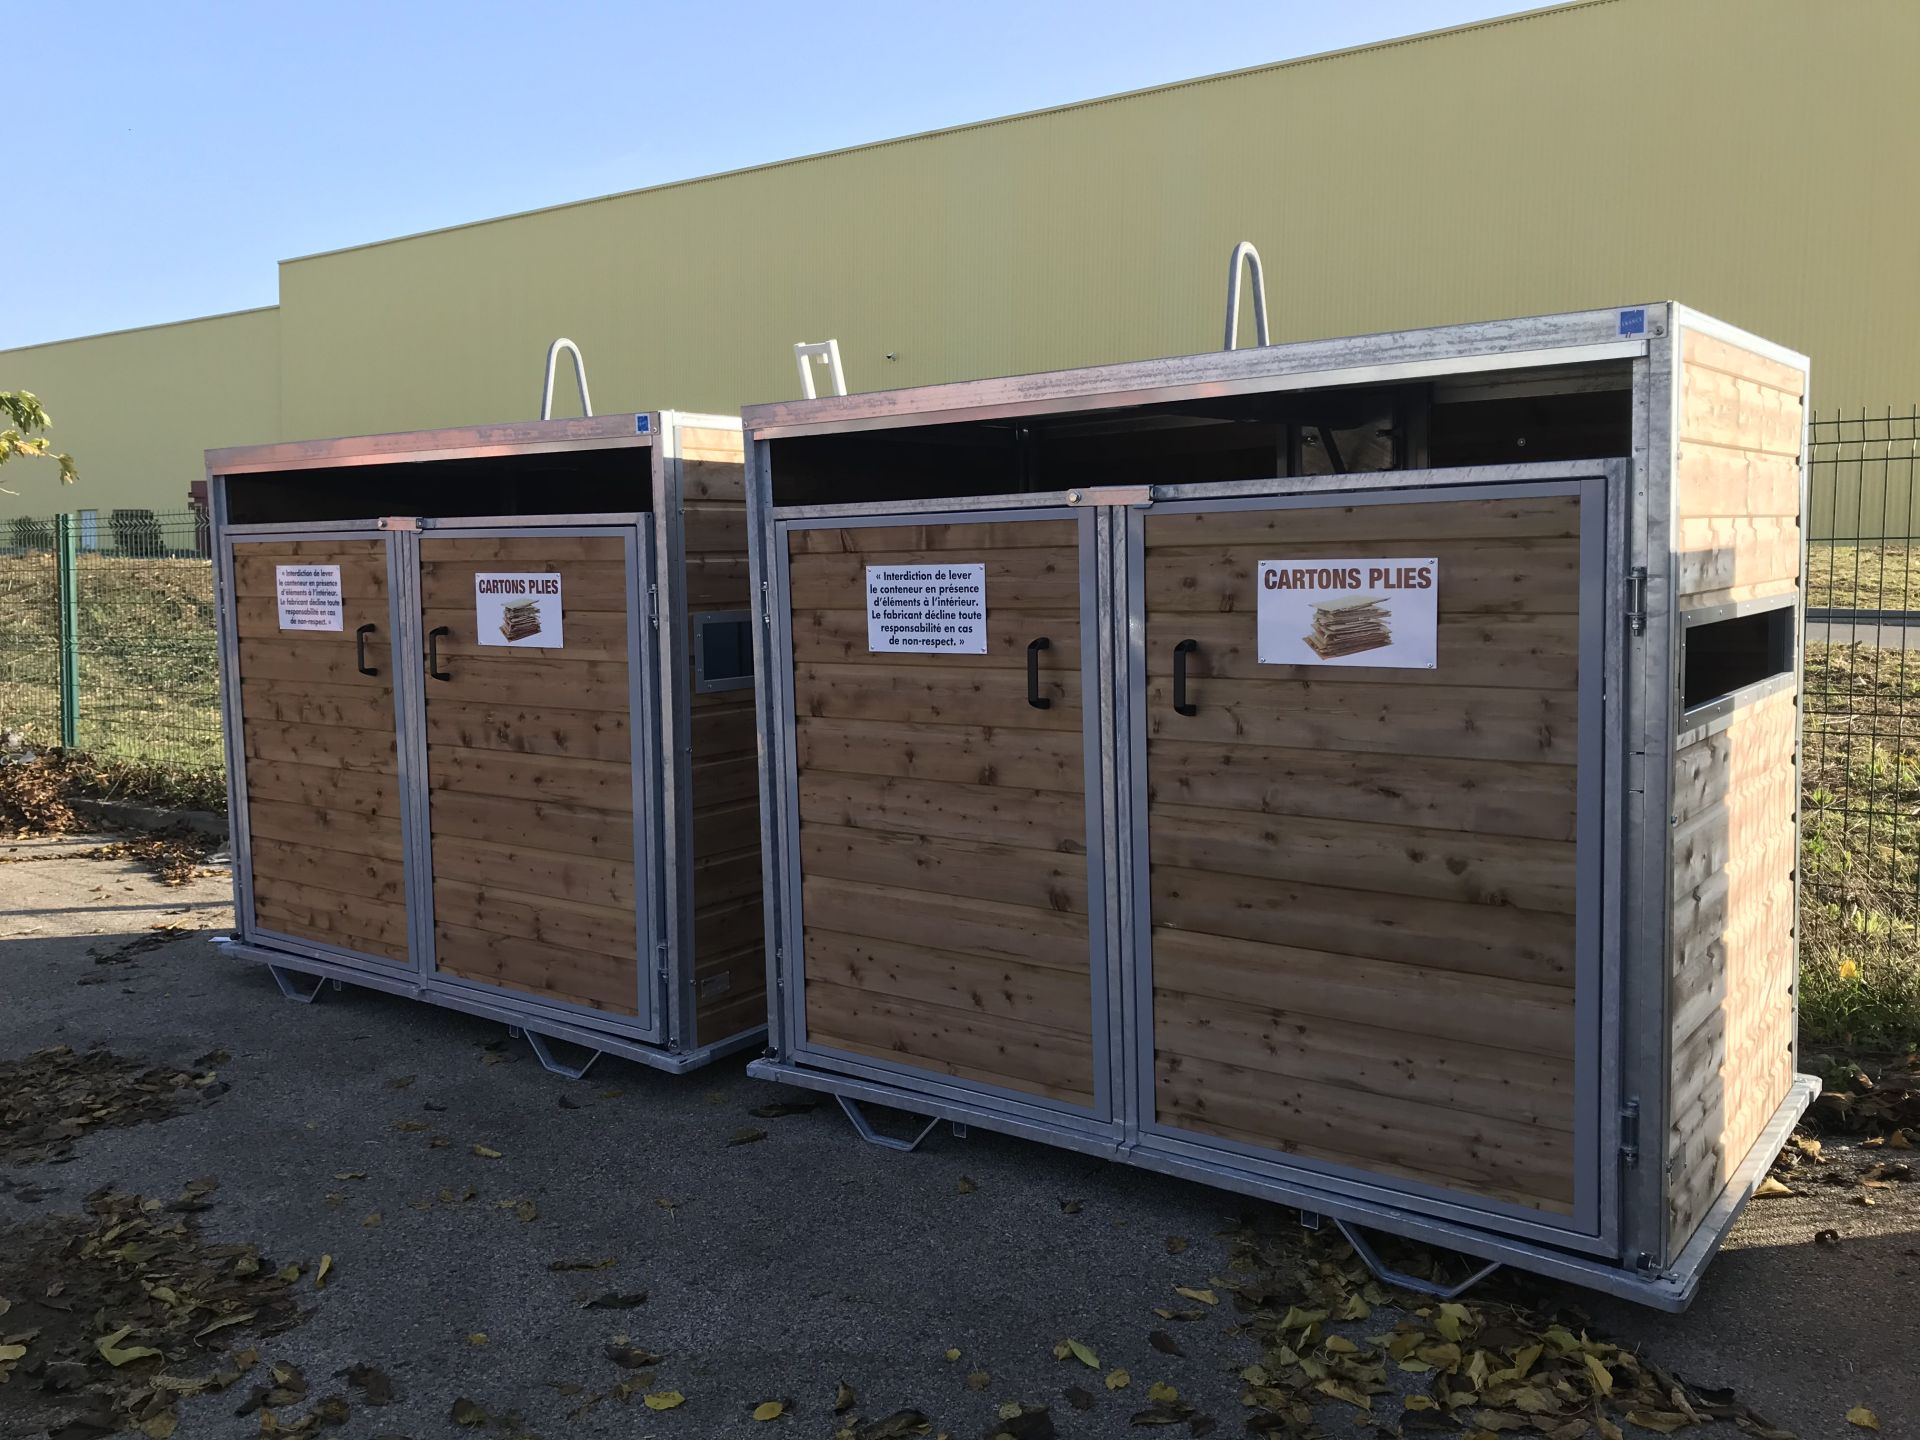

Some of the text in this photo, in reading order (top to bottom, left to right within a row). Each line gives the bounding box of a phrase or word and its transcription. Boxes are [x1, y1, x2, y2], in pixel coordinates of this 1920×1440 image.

[884, 571, 932, 580] Interdiction
[935, 570, 946, 580] de
[949, 570, 971, 579] lever
[1264, 567, 1432, 589] CARTONS PLIES
[479, 580, 558, 594] CARTONS PLIES
[870, 584, 877, 593] le
[880, 586, 922, 594] conteneur
[939, 584, 979, 595] présence
[924, 597, 929, 606] à
[872, 610, 981, 619] Le fabricant décline toute
[881, 623, 941, 634] responsabilité
[889, 636, 899, 645] de
[902, 638, 956, 648] non-respect.
